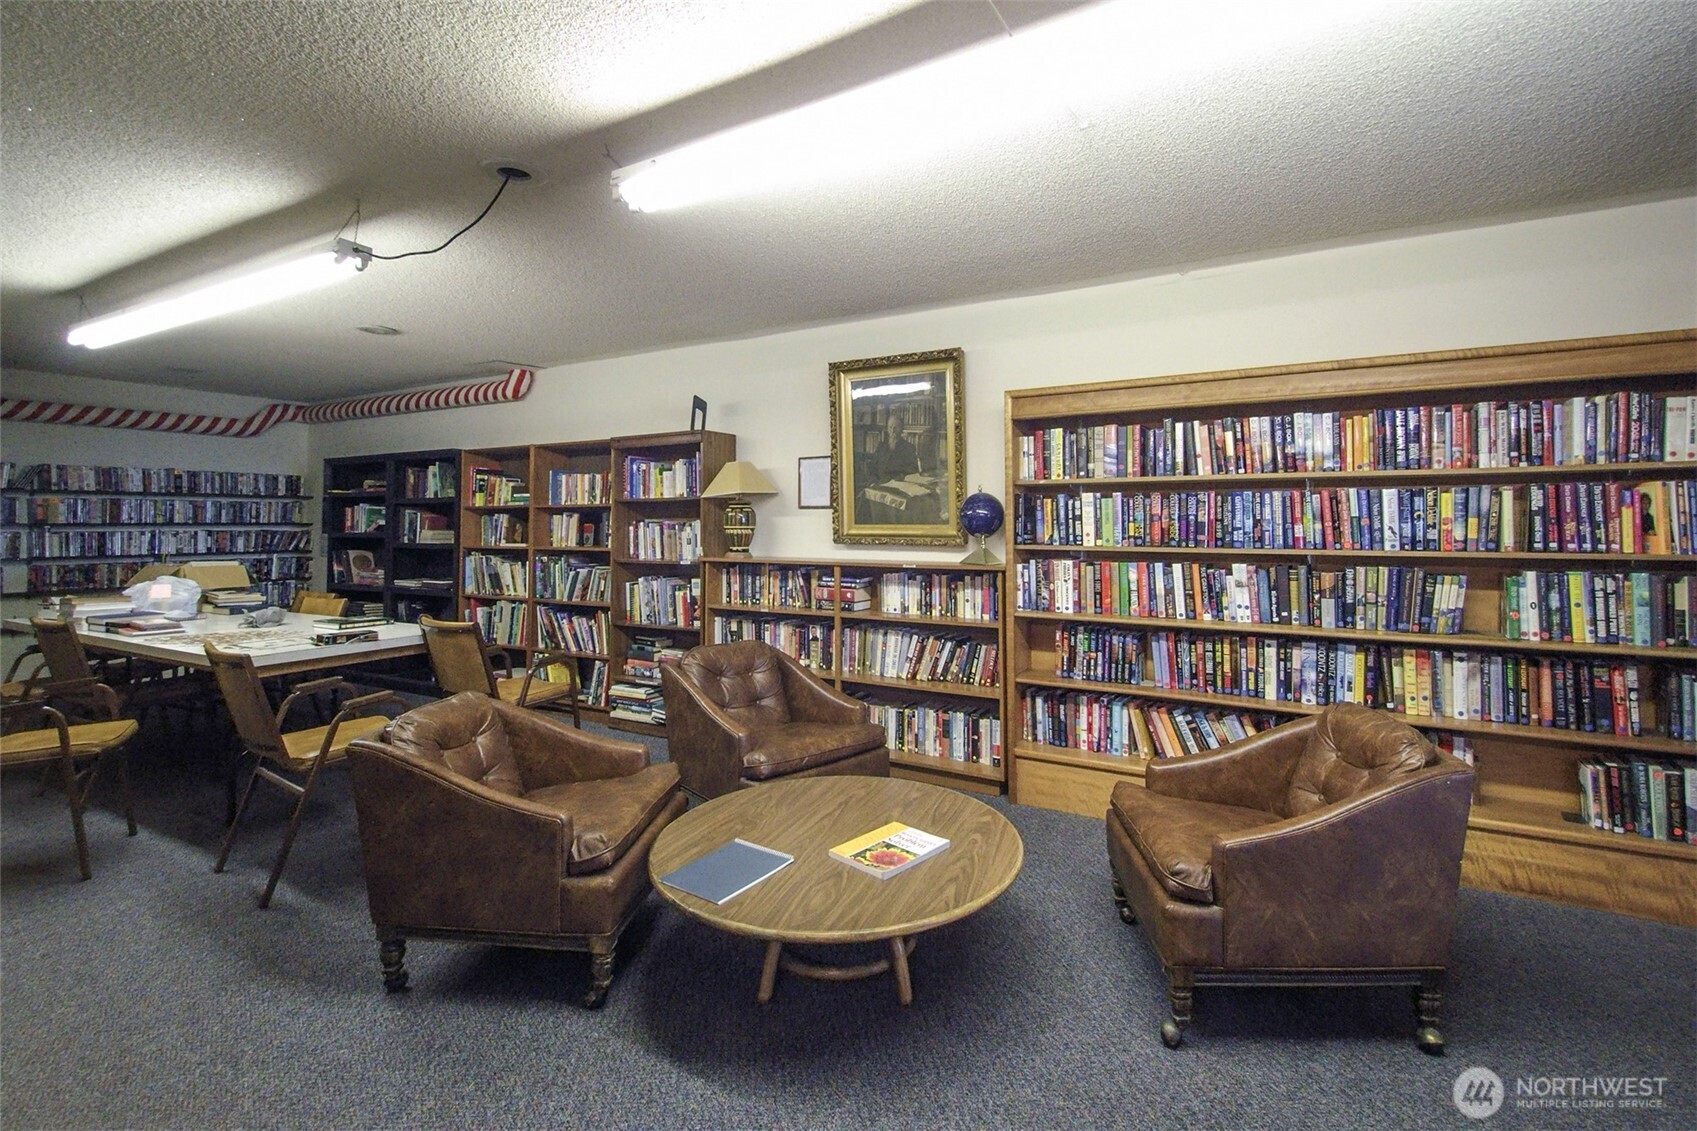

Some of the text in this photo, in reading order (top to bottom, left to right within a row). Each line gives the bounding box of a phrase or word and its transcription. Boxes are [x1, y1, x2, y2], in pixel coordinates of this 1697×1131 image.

[1396, 410, 1406, 426] DALE
[1396, 426, 1406, 449] BROWN
[1346, 585, 1354, 604] GRISHAM
[1317, 646, 1326, 673] KOONTZ
[1328, 652, 1336, 677] KOONTZ
[1640, 784, 1648, 803] ROBERTS
[888, 837, 912, 849] Solver
[893, 833, 927, 849] Problem
